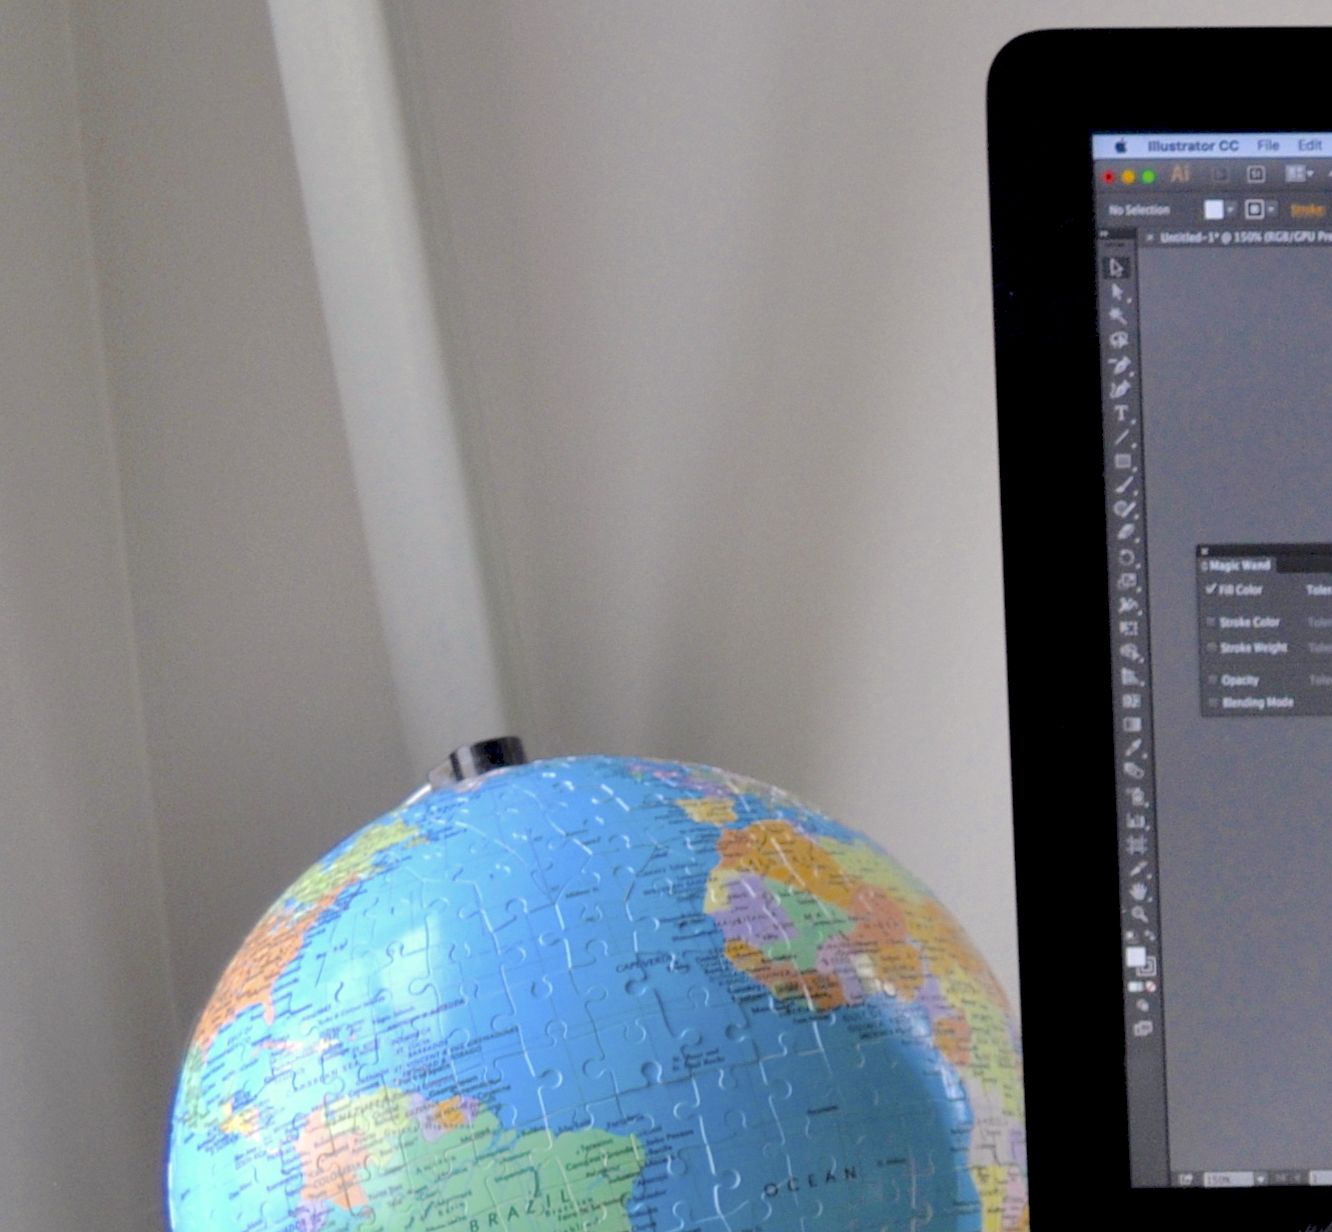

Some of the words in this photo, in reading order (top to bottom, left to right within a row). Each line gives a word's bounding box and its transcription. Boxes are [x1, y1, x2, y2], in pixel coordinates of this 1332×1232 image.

[1148, 140, 1214, 152] Illustrator
[1219, 140, 1239, 152] CC
[1257, 139, 1280, 151] File
[1298, 139, 1322, 151] Edit
[1171, 164, 1191, 182] Ai
[1109, 204, 1122, 215] No
[1125, 204, 1170, 215] Selection
[1209, 559, 1240, 572] Magic
[1242, 559, 1271, 571] Wand
[1218, 584, 1234, 595] Fill
[1236, 584, 1263, 596] Color
[1219, 617, 1250, 629] Stroke
[1253, 617, 1280, 628] Color
[1220, 642, 1252, 654] Stroke
[1221, 674, 1260, 688] Opacity
[1266, 697, 1294, 708] Mode
[763, 1166, 858, 1197] OCEAN
